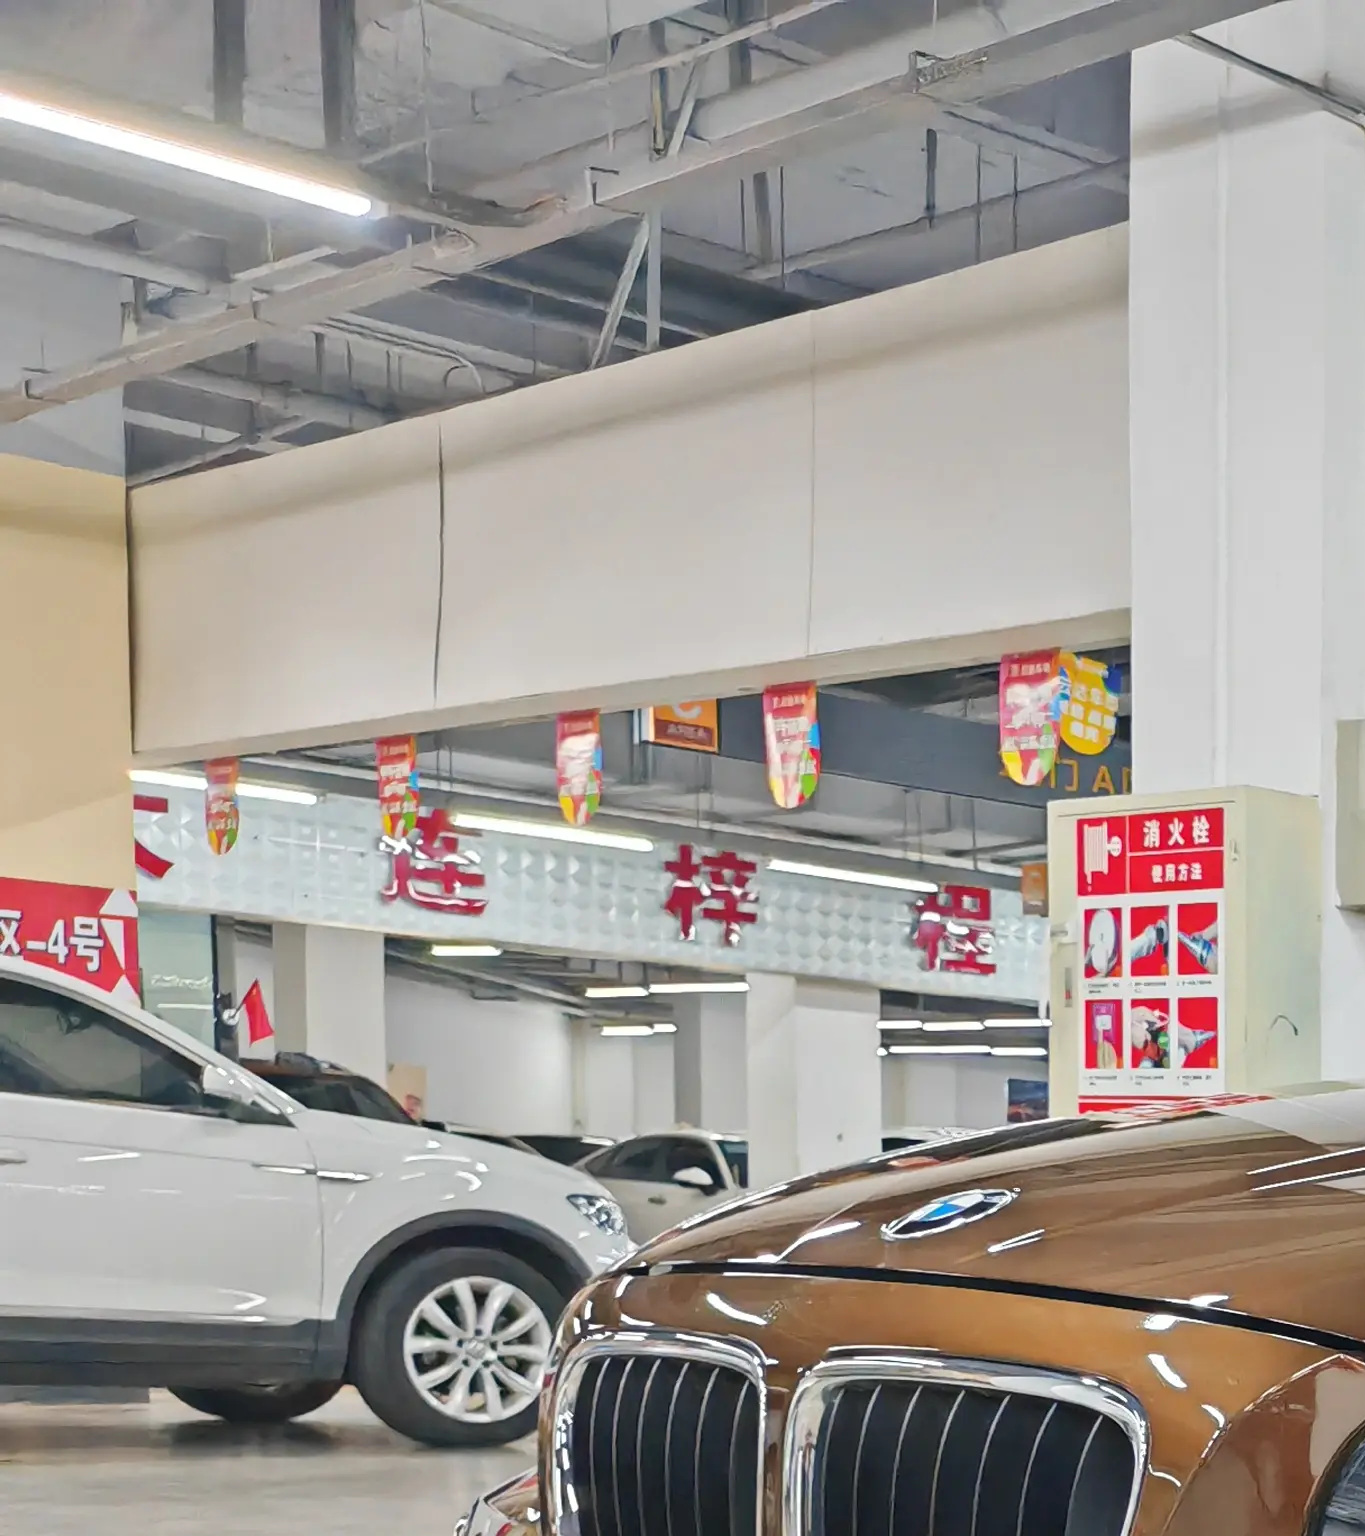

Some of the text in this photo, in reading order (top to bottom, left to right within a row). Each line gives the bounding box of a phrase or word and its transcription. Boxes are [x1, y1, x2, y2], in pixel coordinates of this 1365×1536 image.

[1143, 815, 1210, 848] 消火栓
[1151, 862, 1203, 884] 使用方法
